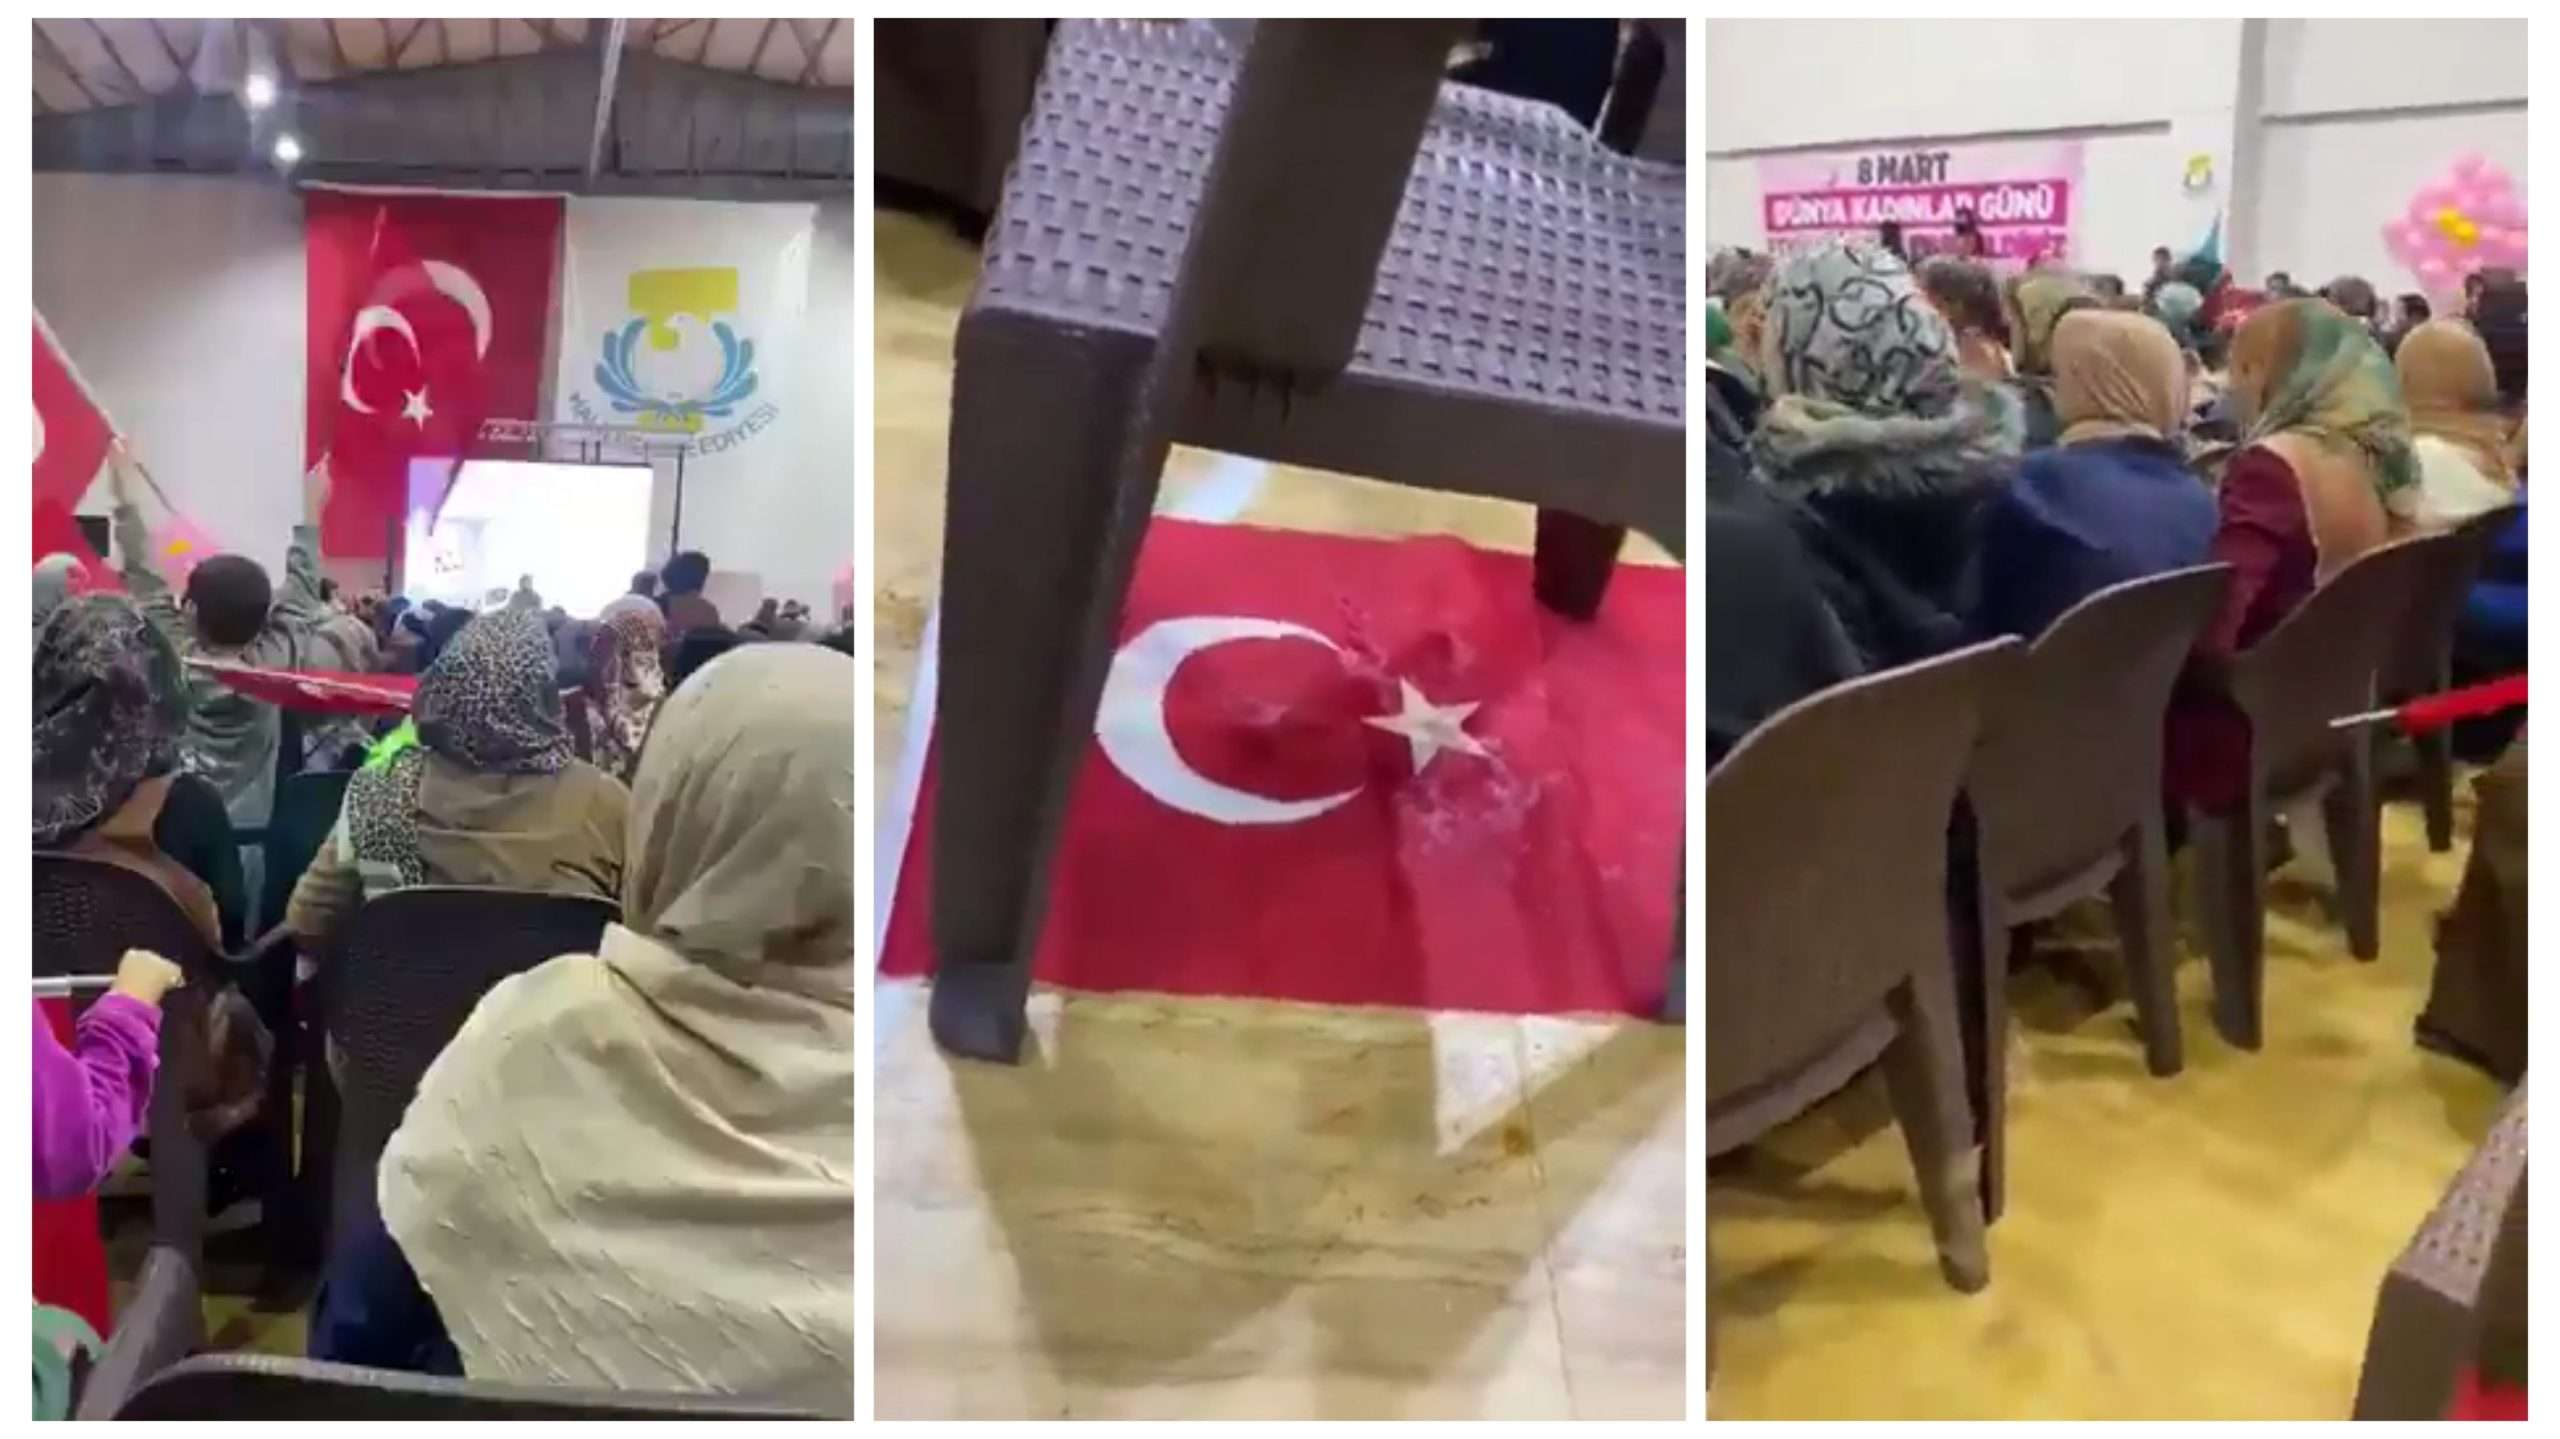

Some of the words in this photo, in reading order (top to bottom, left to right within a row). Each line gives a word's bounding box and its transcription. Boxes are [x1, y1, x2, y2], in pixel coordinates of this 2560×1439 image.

[1857, 157, 1873, 185] 8
[1877, 152, 1949, 184] MART
[1979, 184, 2055, 221] GÜNÜ
